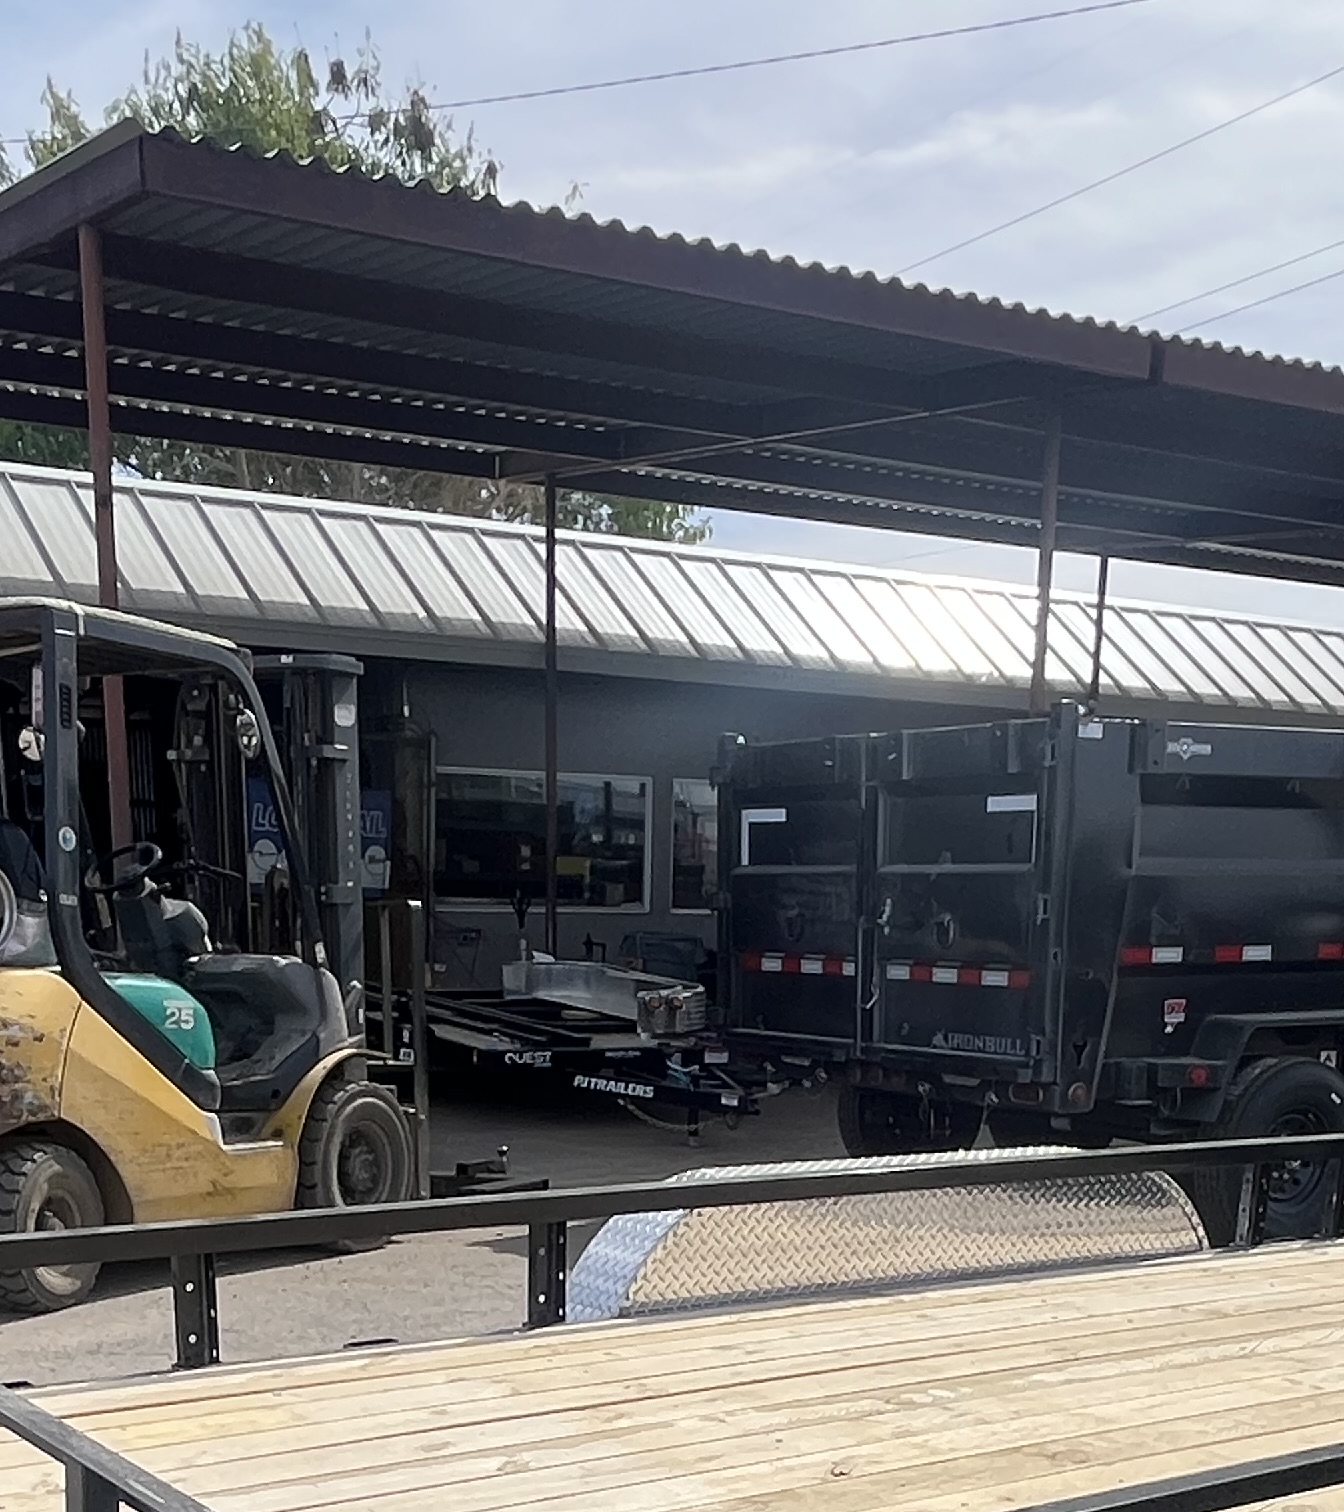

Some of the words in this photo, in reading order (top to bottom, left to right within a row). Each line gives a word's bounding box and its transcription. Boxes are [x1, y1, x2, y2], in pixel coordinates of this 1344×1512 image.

[165, 1008, 195, 1030] 25
[948, 1032, 1026, 1056] IRONBULL
[589, 1078, 654, 1098] TRAILERS
